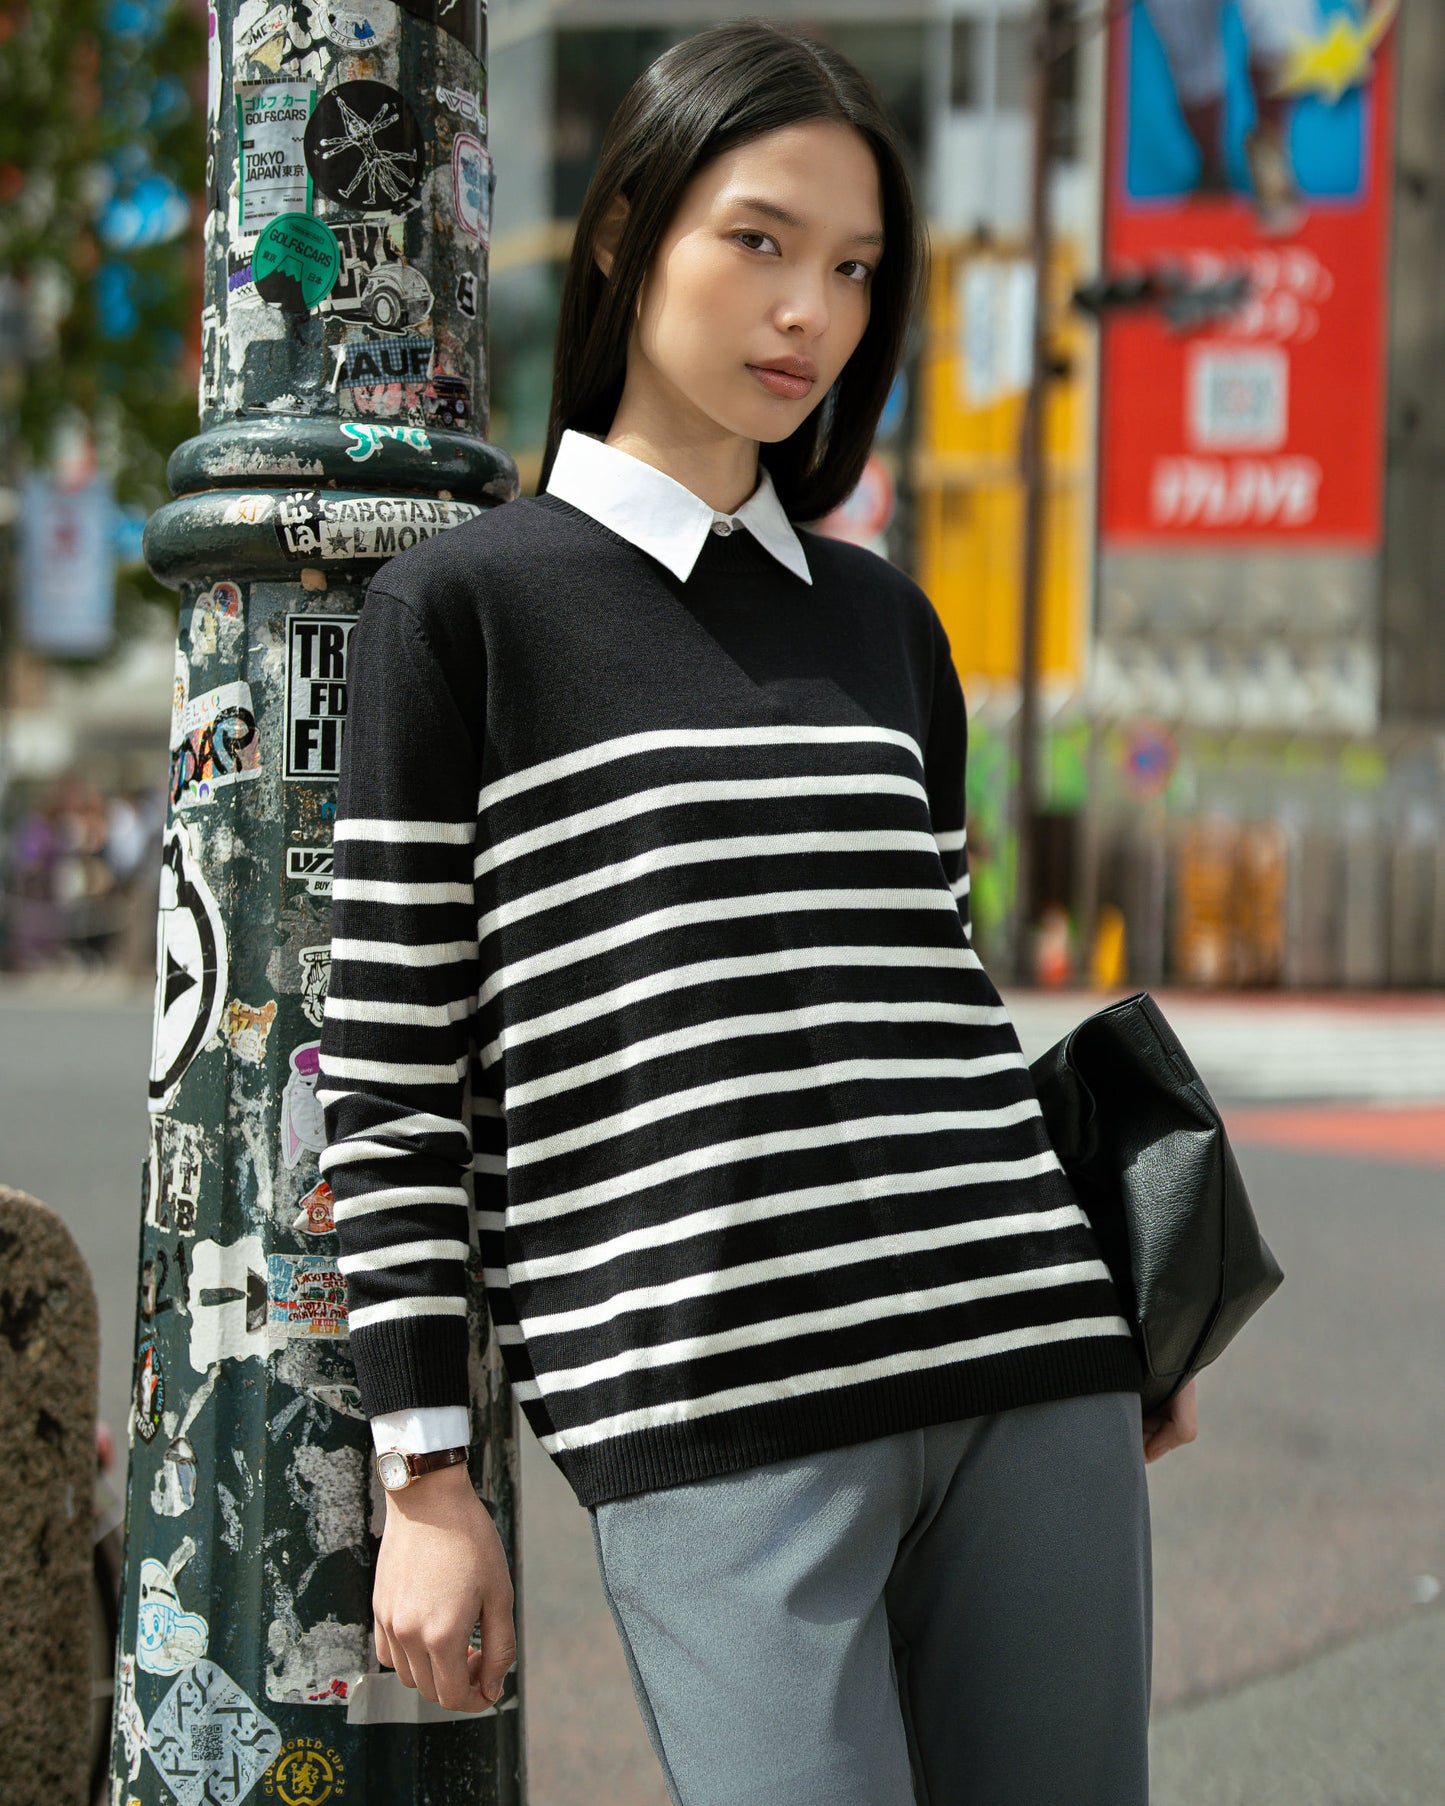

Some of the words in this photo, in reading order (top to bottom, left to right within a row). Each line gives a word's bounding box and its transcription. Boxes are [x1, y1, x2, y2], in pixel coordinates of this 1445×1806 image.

[245, 109, 307, 125] GOLF&CARS
[245, 150, 285, 168] TOKYO
[245, 165, 281, 182] JAPAN
[282, 165, 304, 177] 東京
[269, 228, 333, 267] GOLF&CARS
[323, 500, 451, 524] SABOTAJE
[374, 526, 450, 552] MON
[295, 624, 357, 678] TR
[295, 719, 345, 770] FI
[314, 881, 330, 890] BUY
[326, 1748, 344, 1772] CUP
